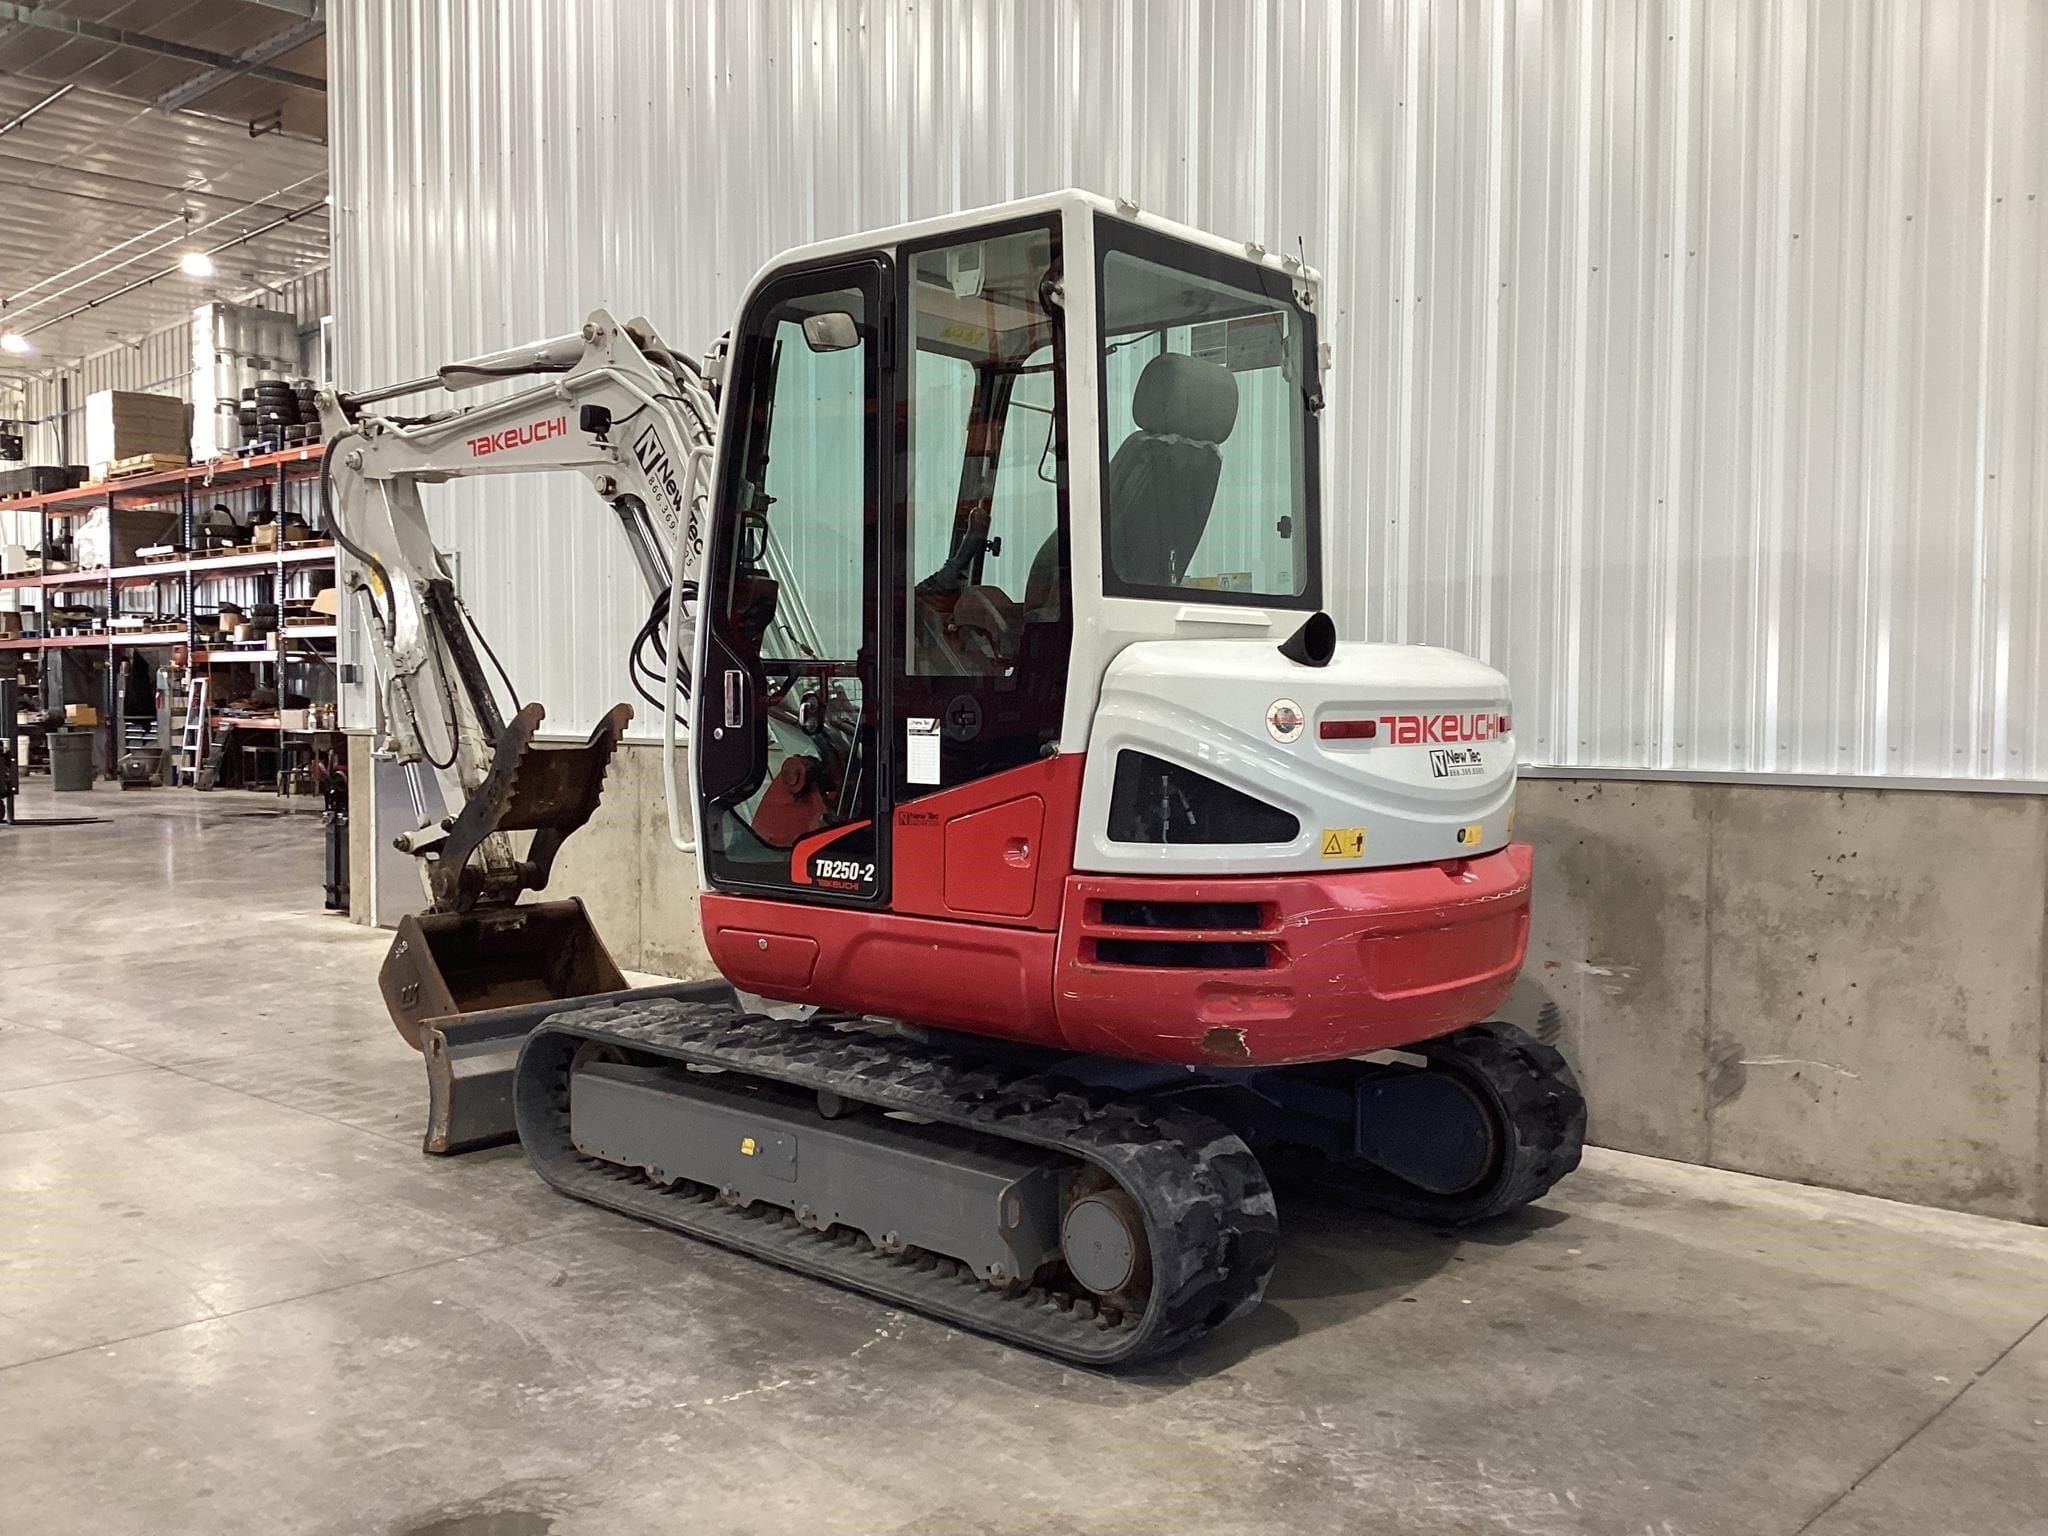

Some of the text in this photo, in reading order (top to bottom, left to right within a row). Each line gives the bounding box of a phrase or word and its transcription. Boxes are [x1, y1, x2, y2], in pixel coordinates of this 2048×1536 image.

[467, 416, 567, 457] TAKEUCHI
[657, 458, 683, 512] New
[1380, 713, 1499, 744] TAKEUCHI
[1446, 750, 1466, 764] New
[1467, 748, 1482, 763] Tec
[816, 859, 875, 882] TB250-2
